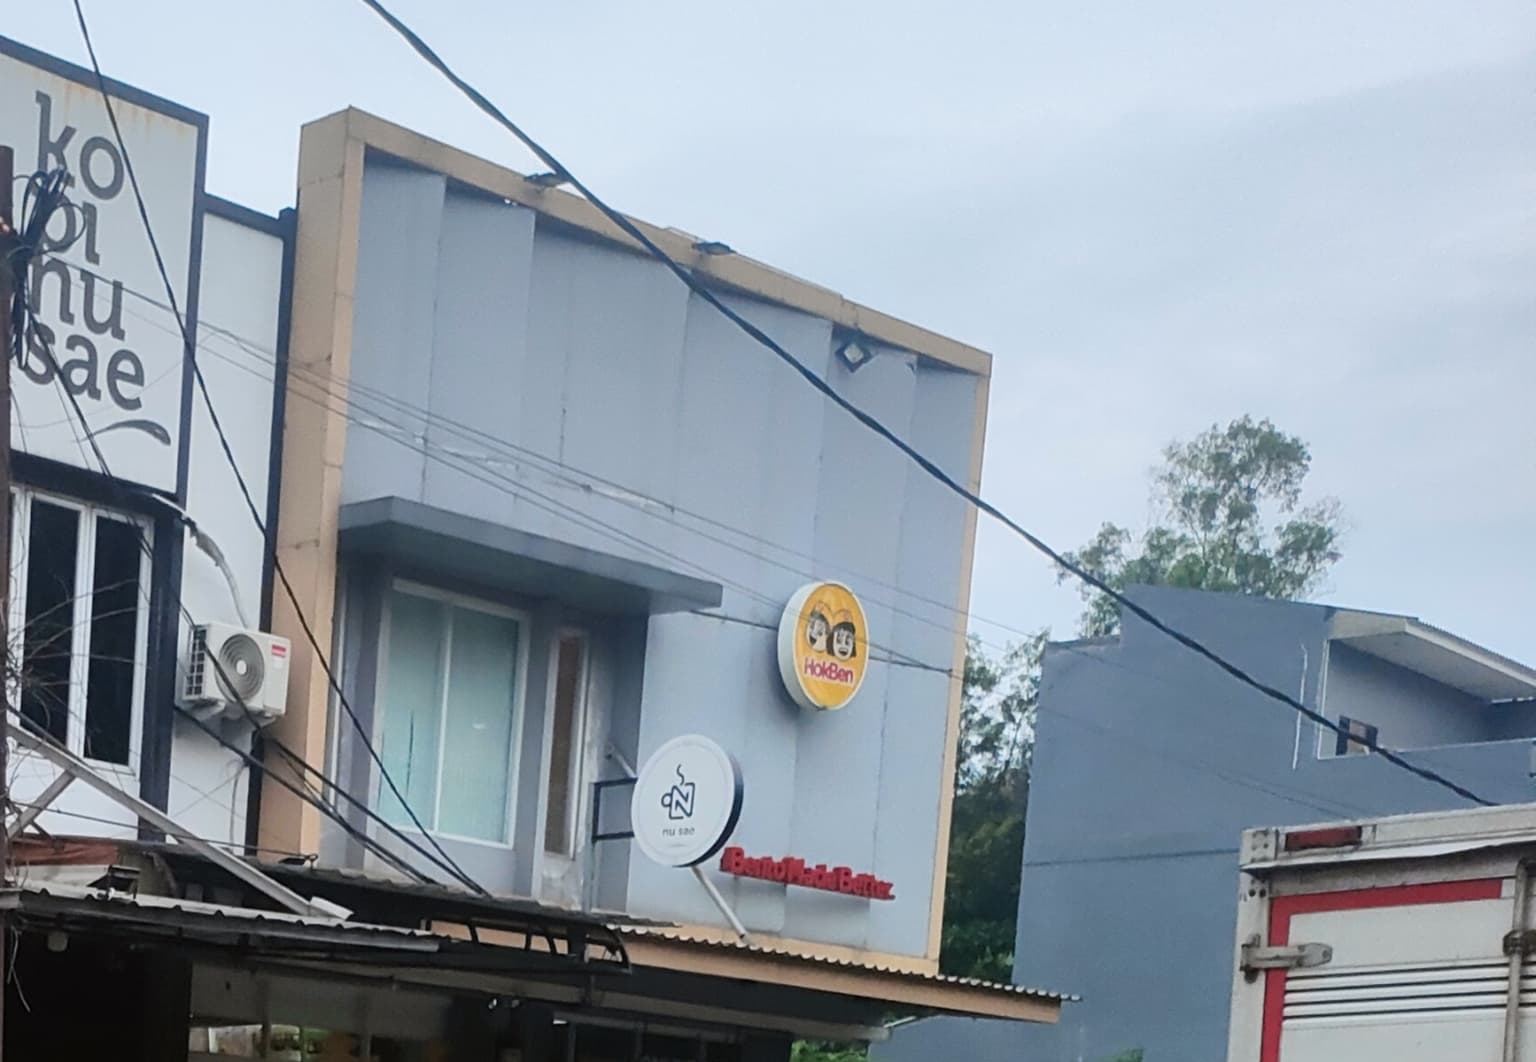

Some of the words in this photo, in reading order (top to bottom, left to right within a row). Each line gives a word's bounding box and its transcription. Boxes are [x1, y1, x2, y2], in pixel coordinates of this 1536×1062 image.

[35, 90, 125, 200] ko
[31, 259, 126, 341] nu
[25, 320, 145, 411] sae
[804, 656, 854, 683] HokBen
[720, 846, 785, 883] Bento
